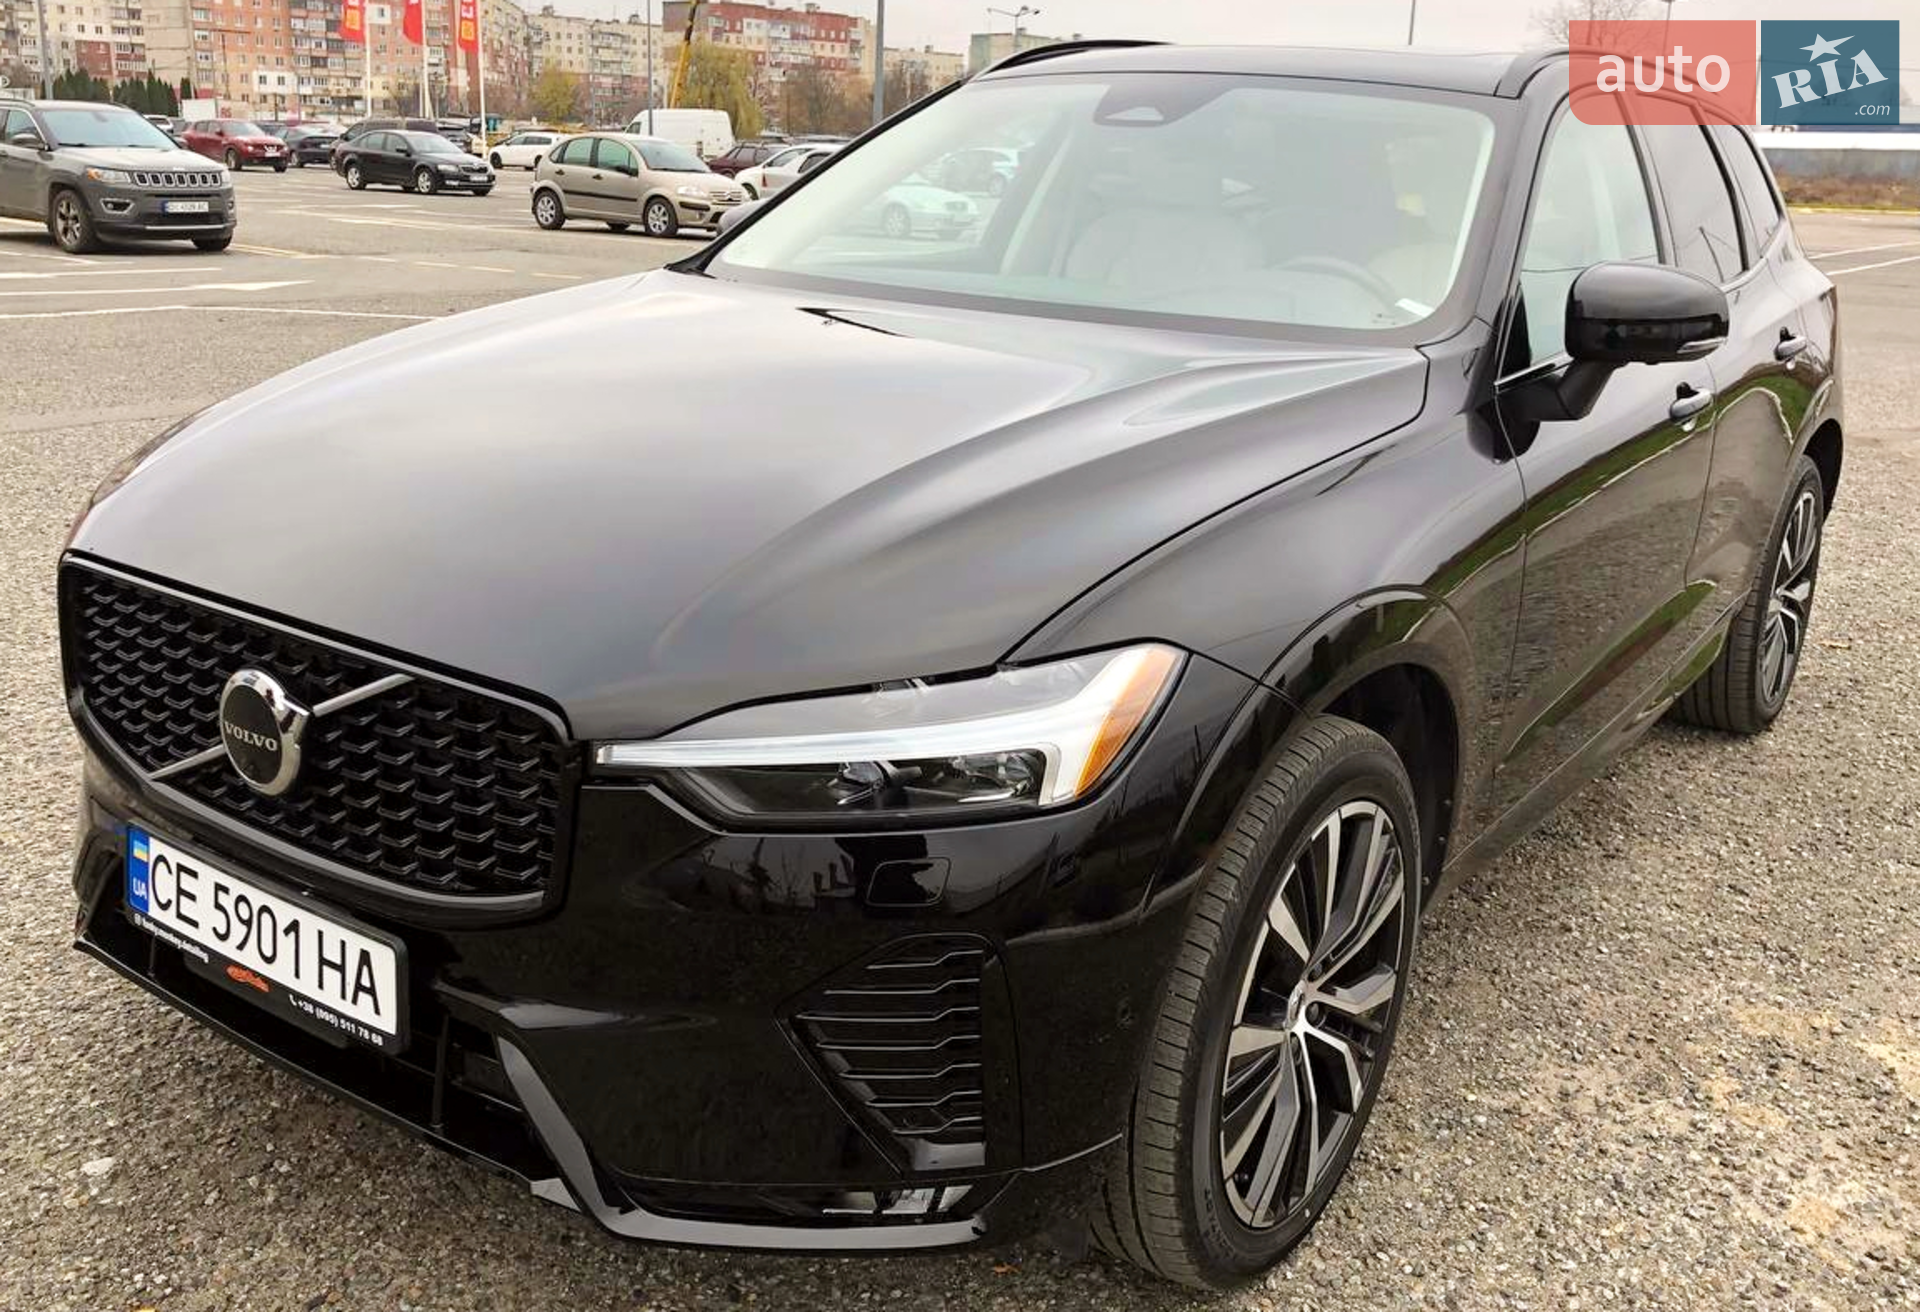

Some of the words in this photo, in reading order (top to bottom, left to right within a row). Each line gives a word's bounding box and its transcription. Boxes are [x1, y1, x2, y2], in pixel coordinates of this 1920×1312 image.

[225, 721, 278, 751] VOLVO
[133, 877, 147, 900] UA
[151, 854, 199, 928] CE
[212, 881, 300, 980] 5901
[317, 930, 381, 1016] HA
